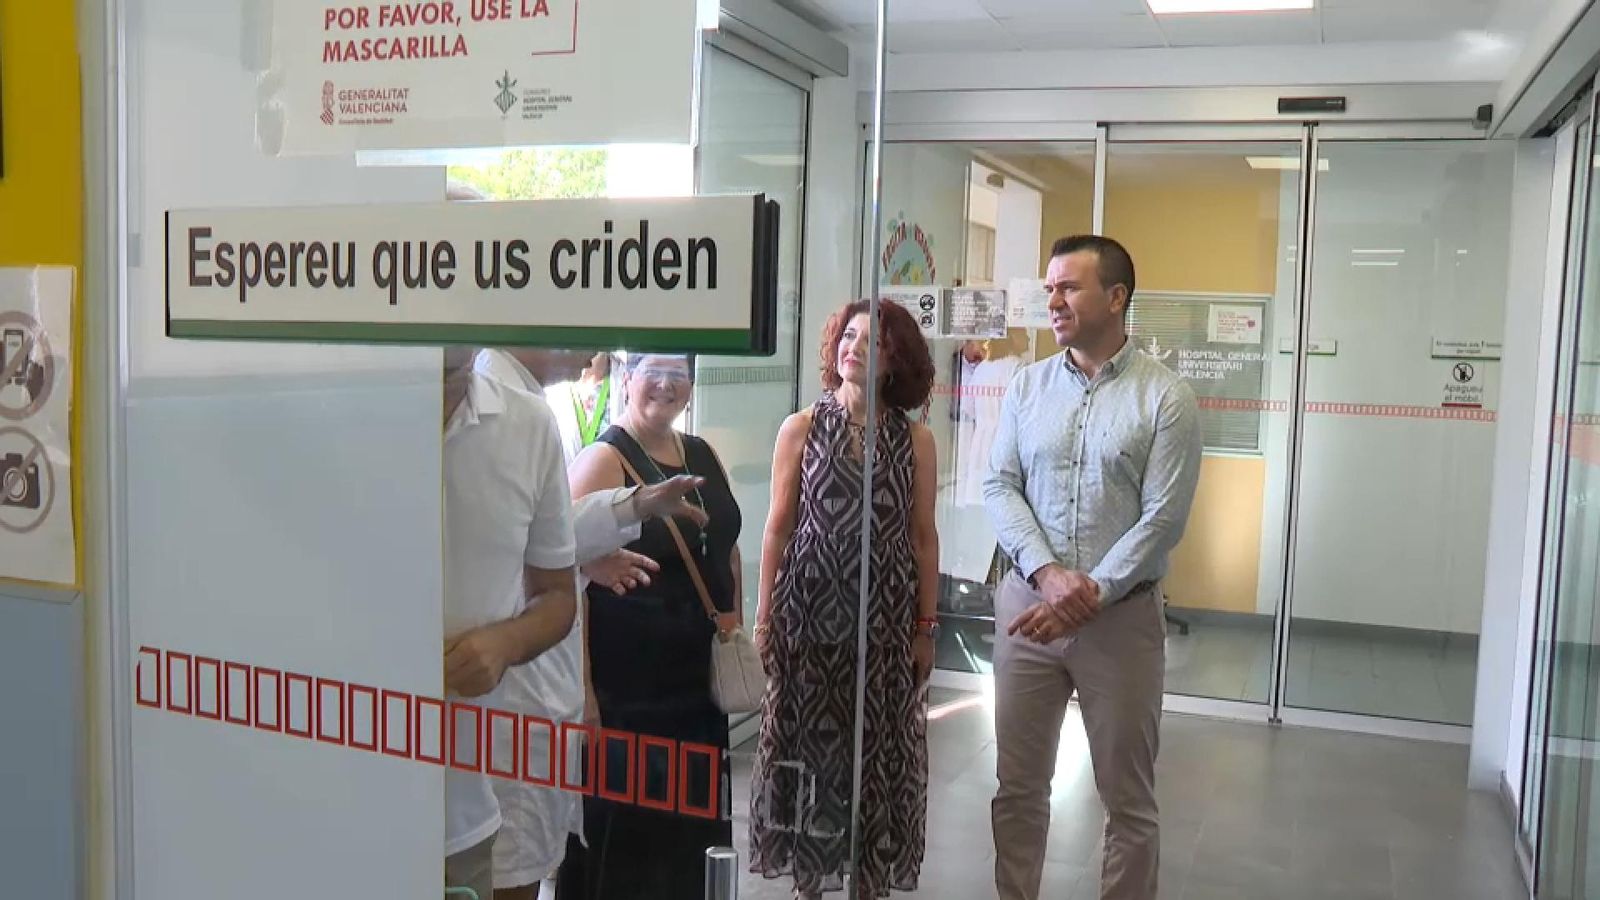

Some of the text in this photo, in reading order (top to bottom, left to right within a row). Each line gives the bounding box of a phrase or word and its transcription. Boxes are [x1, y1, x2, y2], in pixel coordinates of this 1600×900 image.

[325, 0, 549, 30] POR FAVOR, USE LA
[322, 34, 468, 63] MASCARILLA
[338, 88, 410, 101] GENERALITAT
[339, 102, 408, 114] VALENCIANA
[187, 218, 718, 306] Espereu que us criden
[1178, 349, 1222, 359] HOSPITAL
